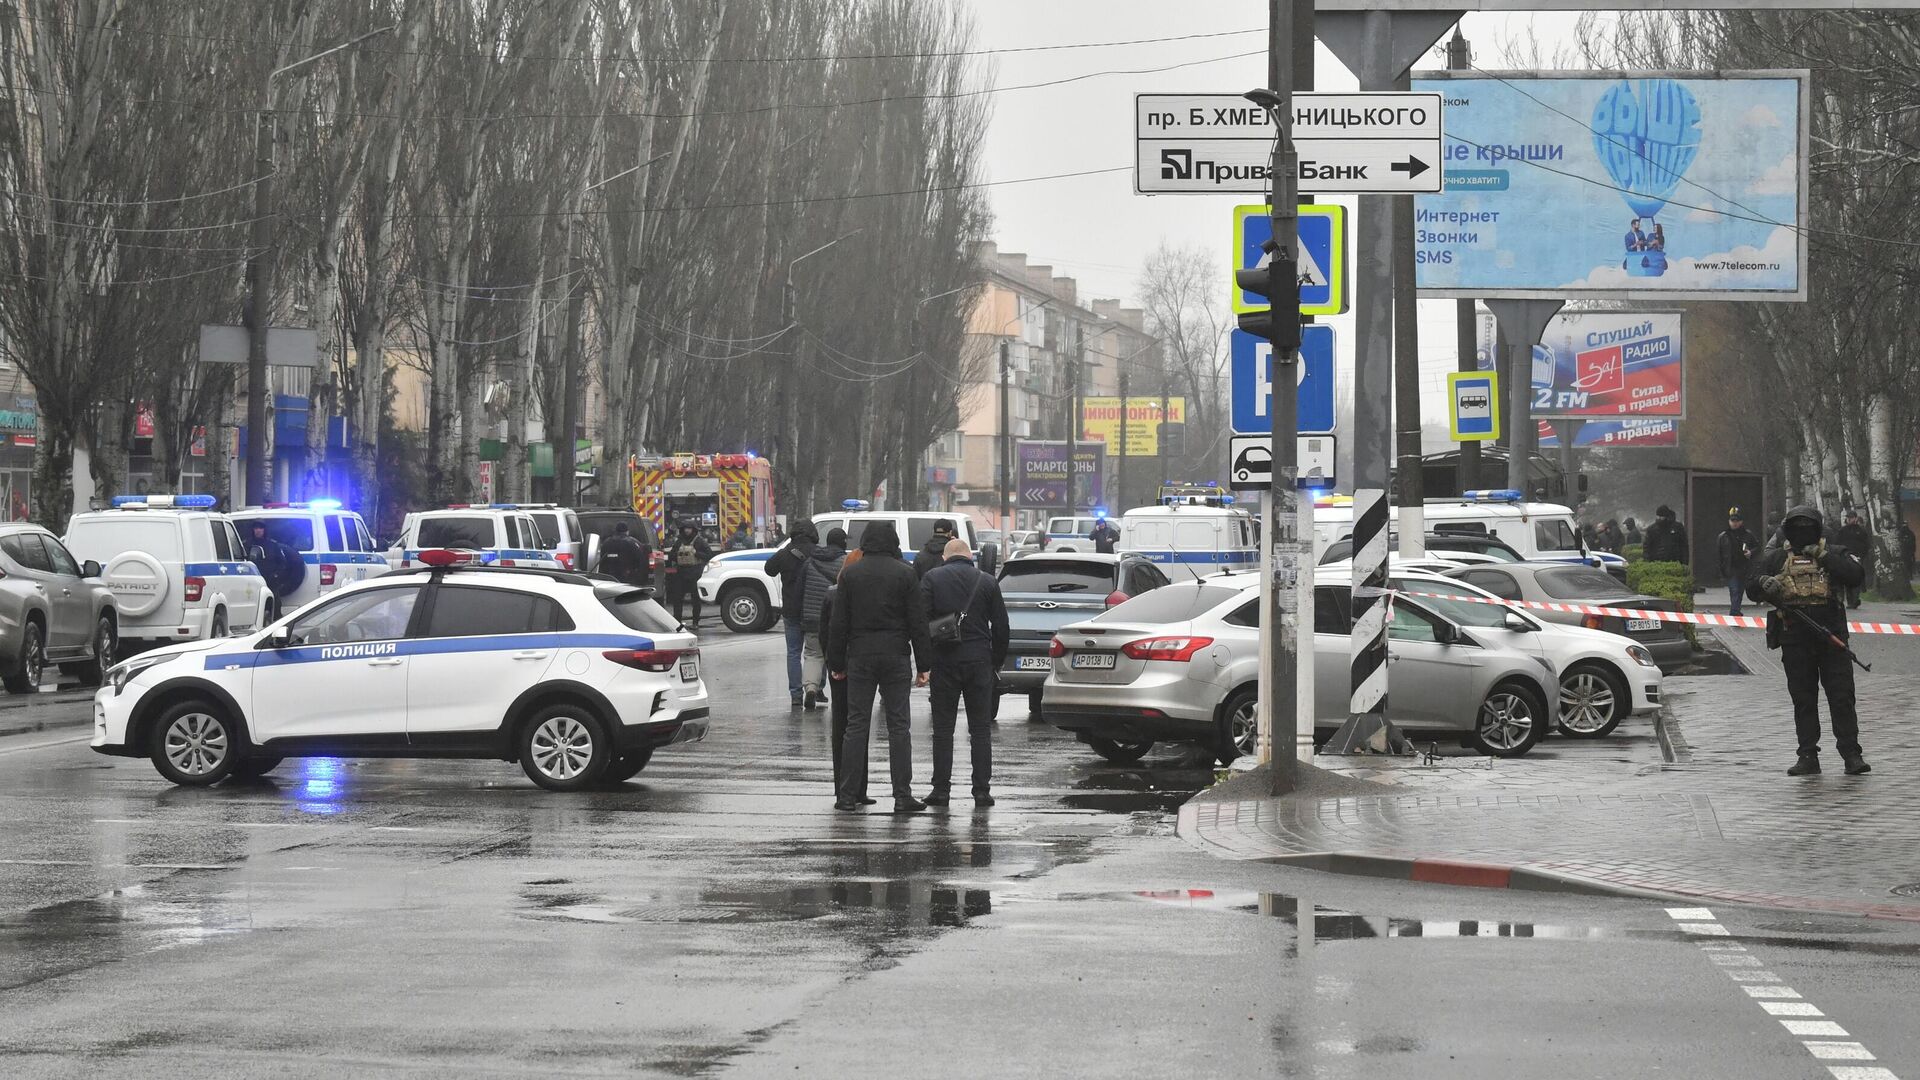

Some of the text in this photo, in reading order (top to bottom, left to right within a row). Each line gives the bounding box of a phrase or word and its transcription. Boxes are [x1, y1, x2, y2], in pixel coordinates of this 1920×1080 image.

[1148, 107, 1427, 130] пр. Б.ХМЕЛНИЦЬКОГО
[1476, 144, 1564, 167] крыши
[1466, 176, 1501, 185] ХВАТИТ!
[1416, 208, 1500, 227] Интернет
[1416, 229, 1478, 243] Звонки
[1416, 250, 1453, 264] SMS
[1694, 261, 1781, 271] www.7telecom.ru
[1625, 340, 1668, 360] РАДИО
[1555, 391, 1589, 409] FM
[1631, 385, 1664, 399] Сила
[1618, 391, 1680, 413] в правде!
[1604, 419, 1673, 442] в правде!
[107, 582, 159, 590] PATRIOT
[321, 643, 397, 659] ПОЛИЦИЯ
